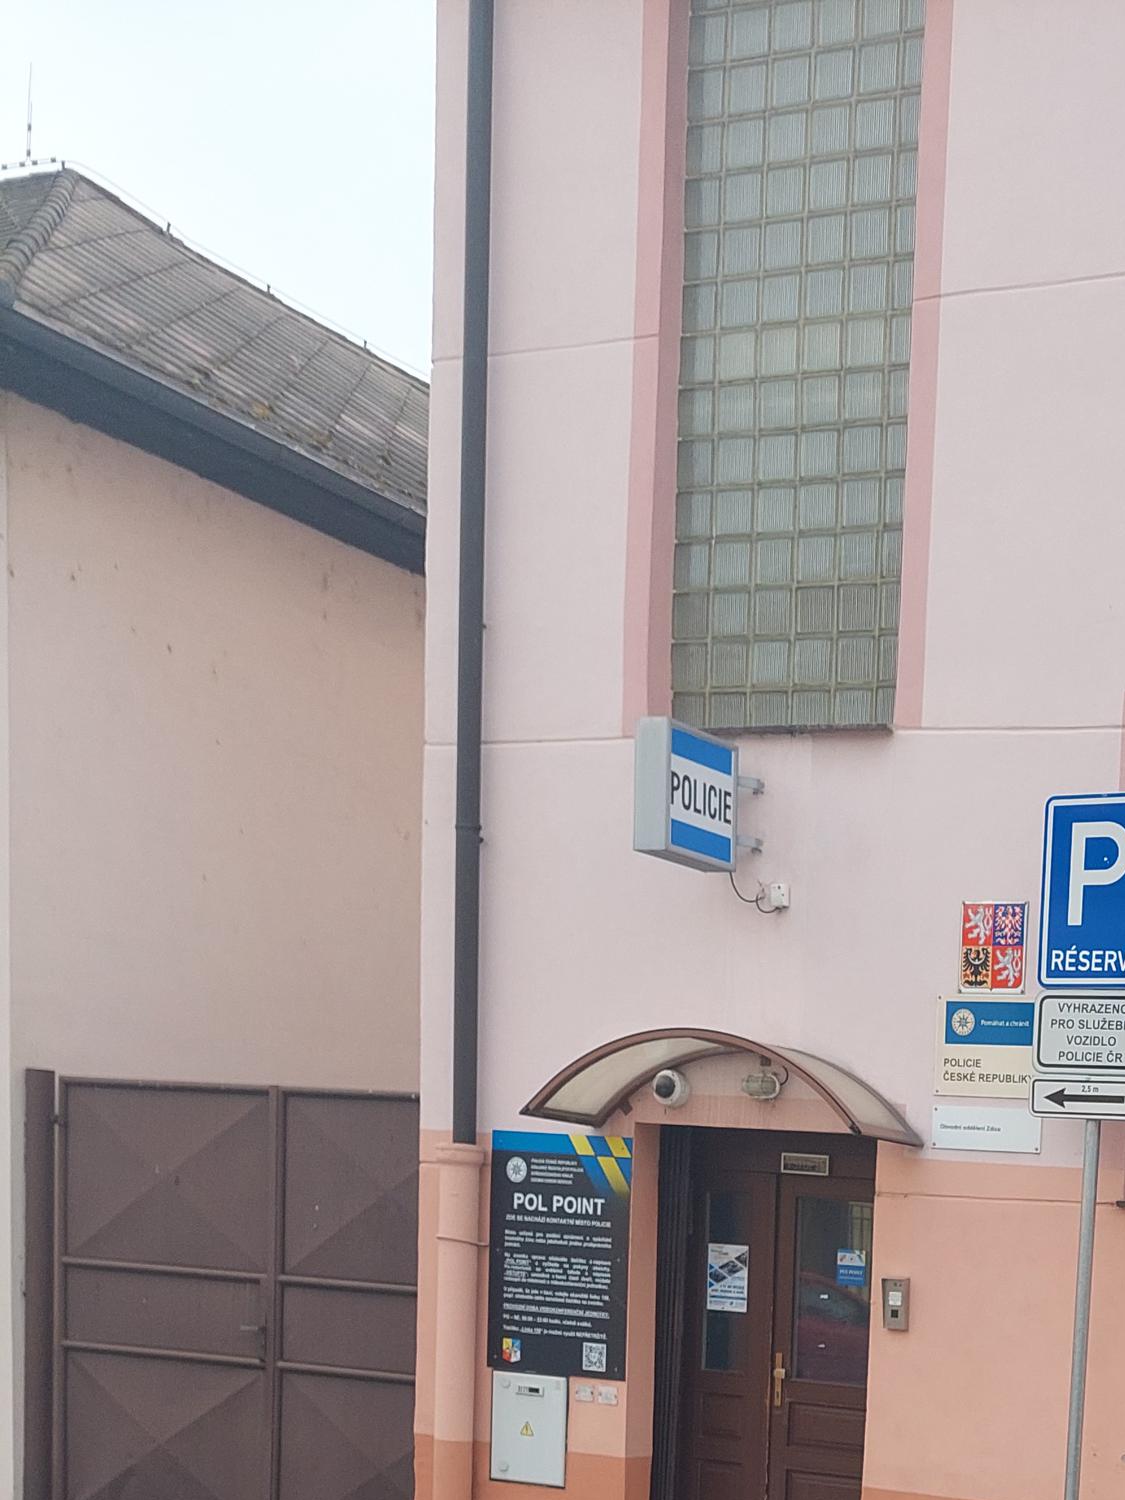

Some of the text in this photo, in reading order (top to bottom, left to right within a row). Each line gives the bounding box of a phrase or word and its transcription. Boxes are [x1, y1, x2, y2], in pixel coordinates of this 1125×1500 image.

[670, 769, 732, 825] POLICIE
[1050, 1018, 1075, 1029] PRO
[1066, 1035, 1117, 1047] VOZIDLO
[1058, 1050, 1123, 1063] POLICIE ČR
[943, 1058, 982, 1068] POLICIE
[943, 1071, 976, 1082] ČESKÉ
[513, 1192, 606, 1216] POL POINT
